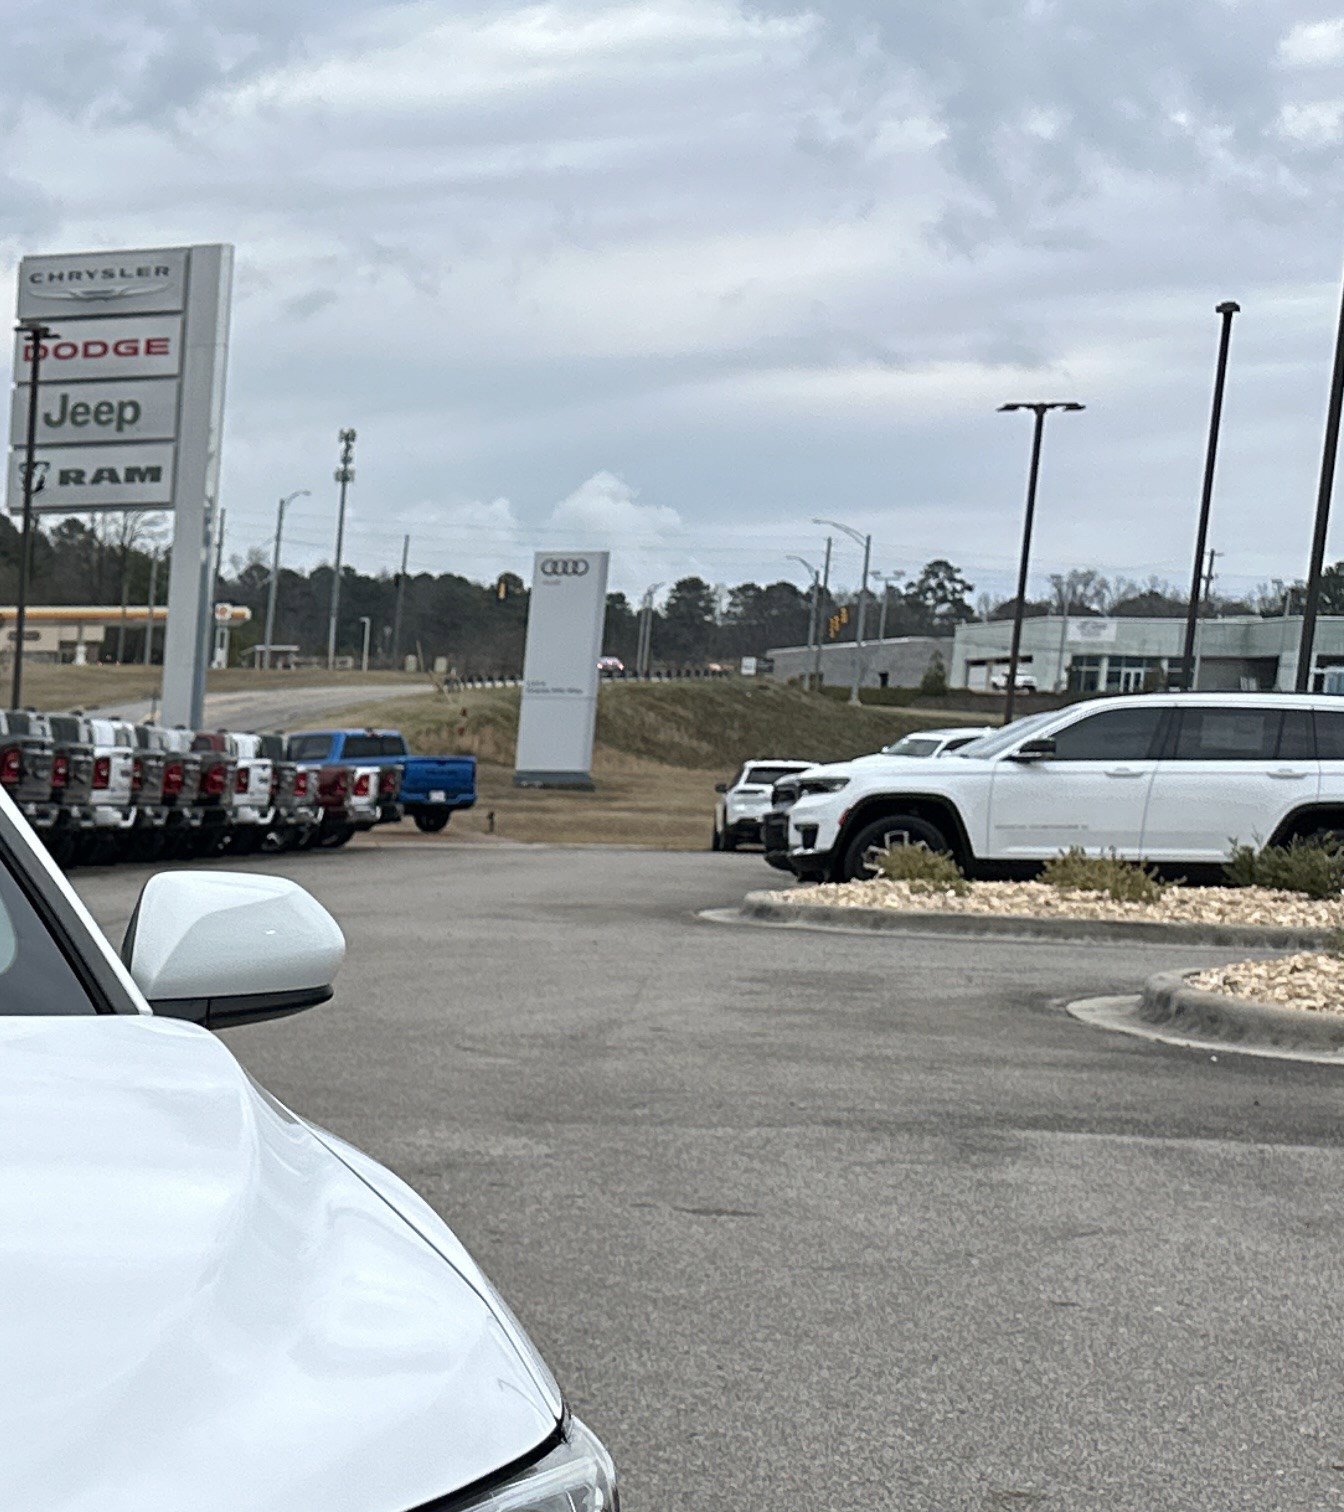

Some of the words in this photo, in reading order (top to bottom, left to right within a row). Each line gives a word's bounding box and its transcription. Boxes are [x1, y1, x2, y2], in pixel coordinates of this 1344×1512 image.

[29, 265, 170, 284] CHRYSLER
[23, 337, 170, 362] DODGE
[43, 393, 141, 432] Jeep
[58, 465, 163, 486] RAM
